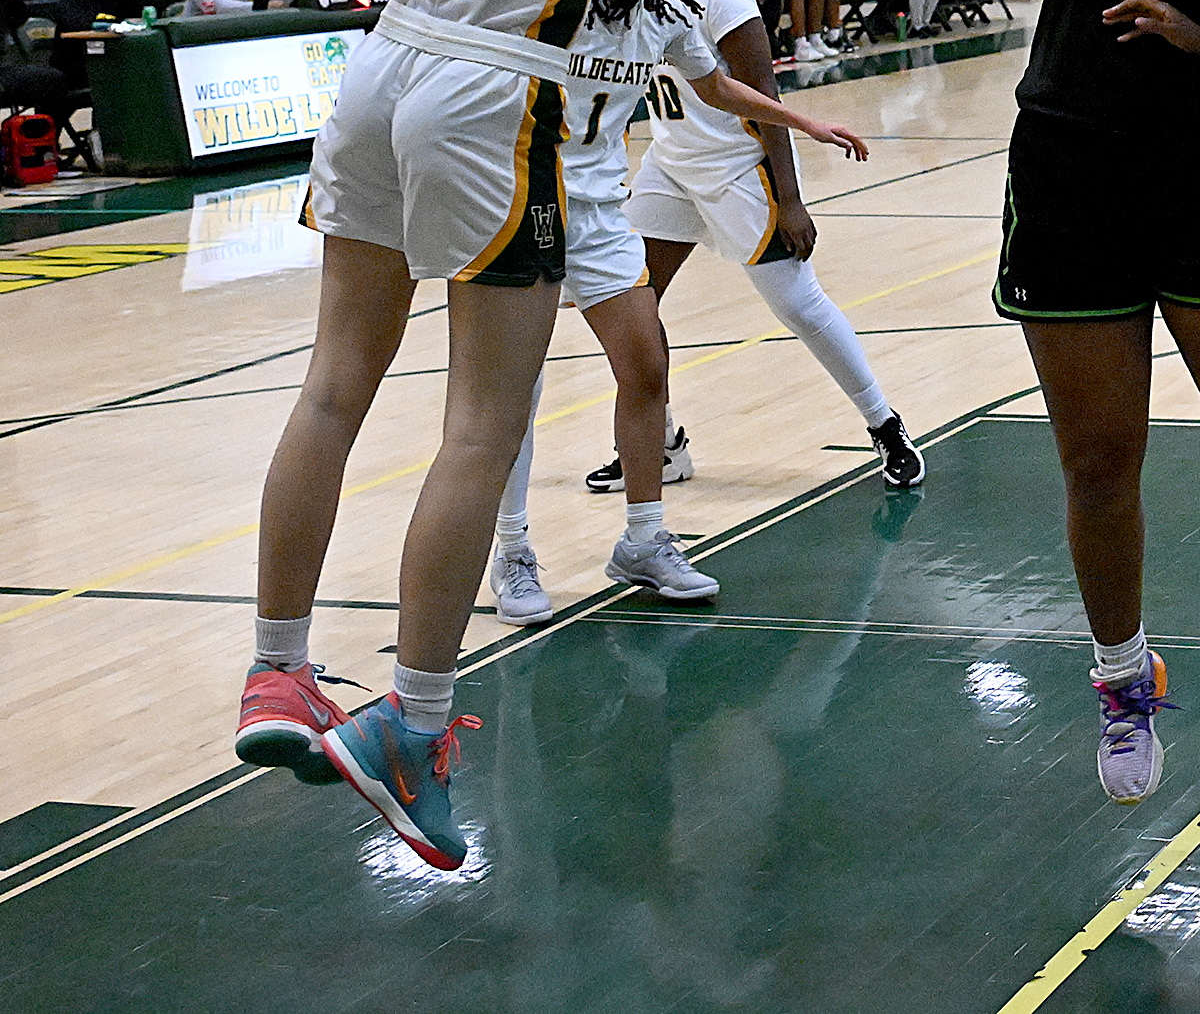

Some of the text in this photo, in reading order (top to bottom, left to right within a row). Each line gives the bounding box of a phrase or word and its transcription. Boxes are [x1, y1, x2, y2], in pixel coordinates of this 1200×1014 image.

[302, 41, 324, 63] GO
[195, 75, 280, 101] WELCOME TO
[193, 96, 297, 149] WILDE
[581, 92, 610, 146] 1
